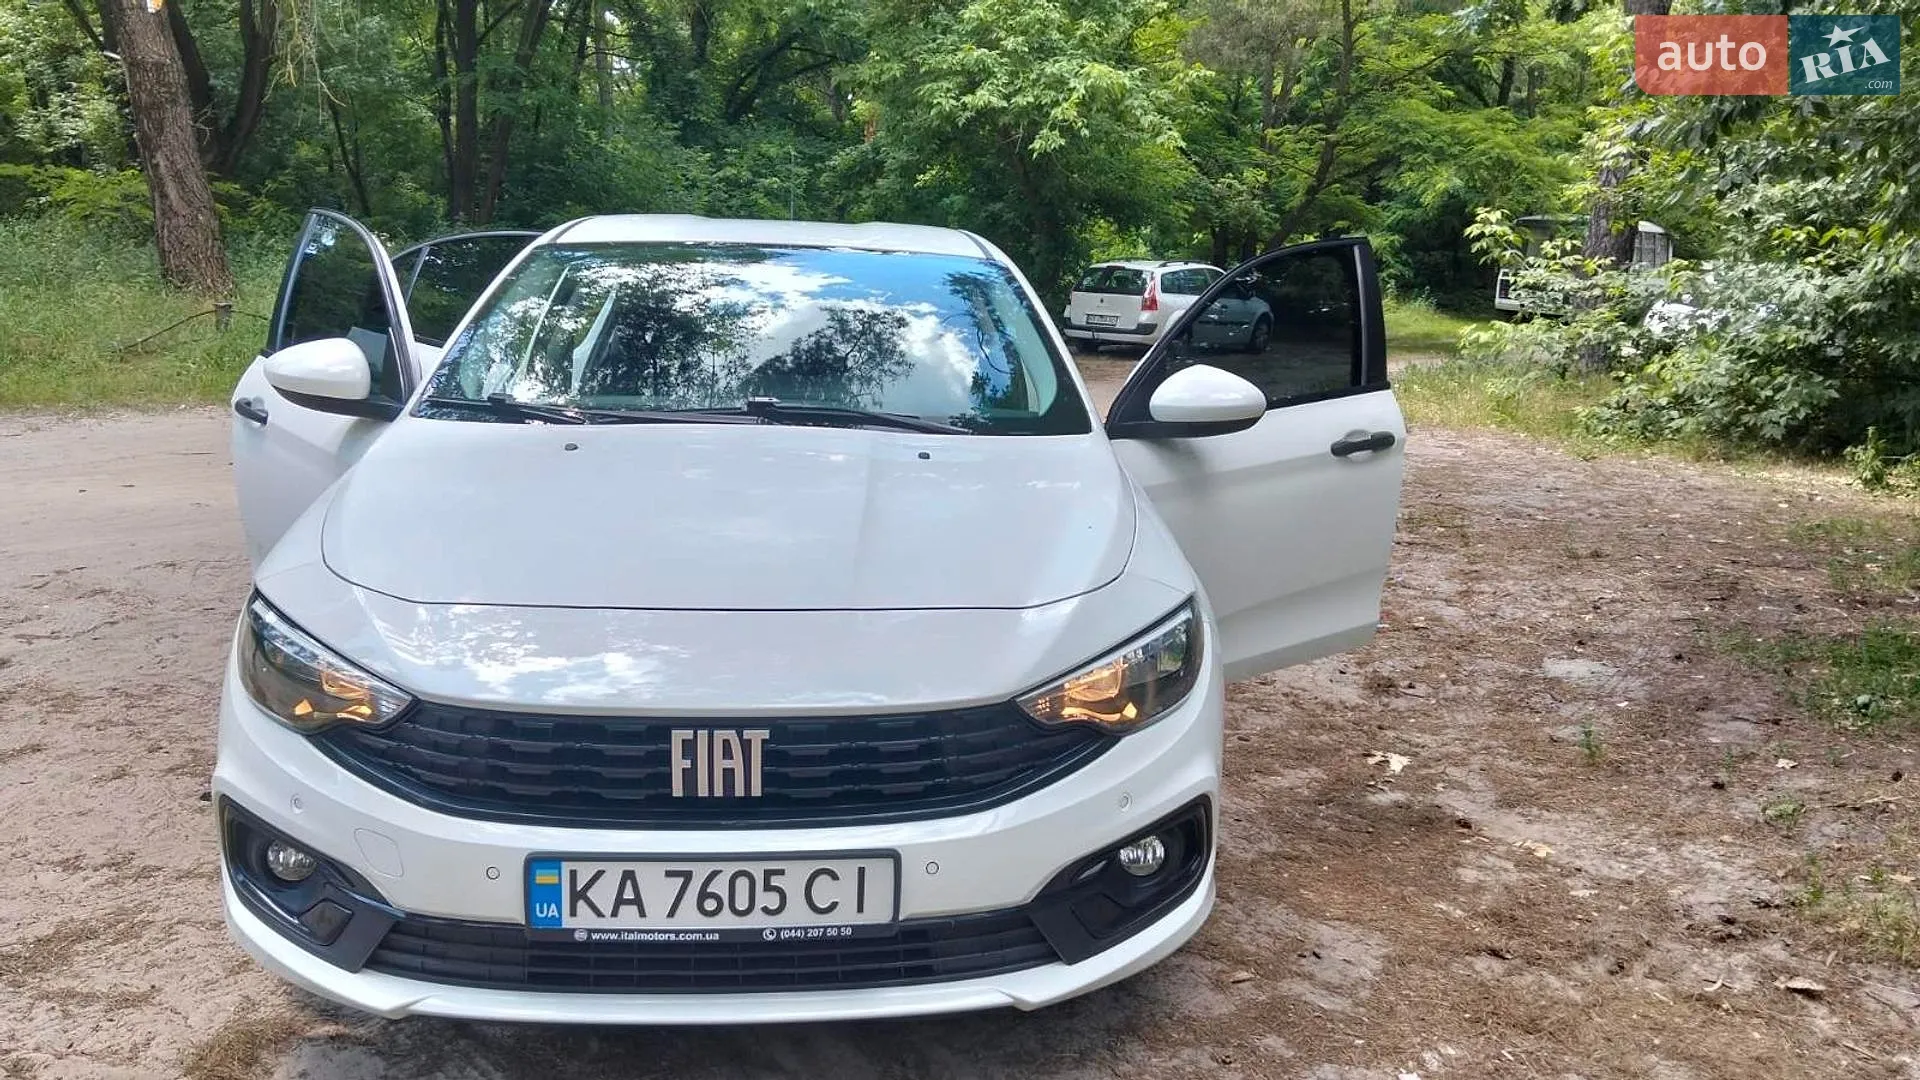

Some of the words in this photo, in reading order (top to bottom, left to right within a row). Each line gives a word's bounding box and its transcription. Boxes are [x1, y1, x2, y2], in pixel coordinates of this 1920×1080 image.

[671, 729, 770, 797] FIAT
[568, 868, 648, 919] KA
[664, 867, 788, 918] 7605
[535, 902, 560, 919] UA
[591, 930, 720, 942] www.italmotors.com.ua
[780, 928, 805, 941] (044)
[807, 927, 824, 938] 207
[826, 926, 838, 937] 50
[840, 926, 852, 936] 50
